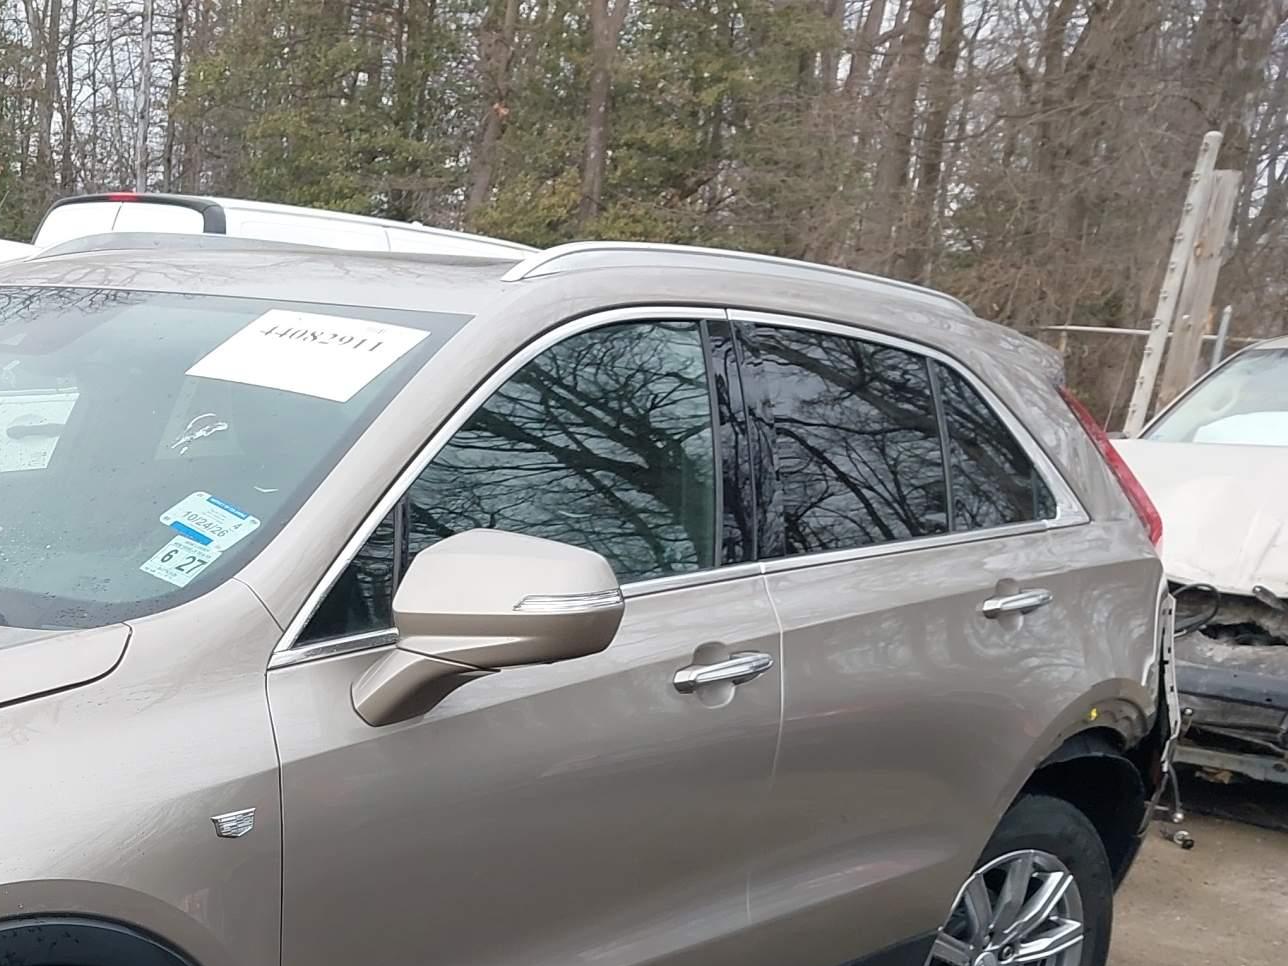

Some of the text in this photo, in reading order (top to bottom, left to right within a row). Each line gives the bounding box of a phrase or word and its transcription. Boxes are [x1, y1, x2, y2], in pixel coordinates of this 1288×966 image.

[260, 325, 384, 351] 44082911
[183, 511, 229, 538] 10/24/26
[160, 549, 178, 563] 6
[175, 555, 208, 574] 27
